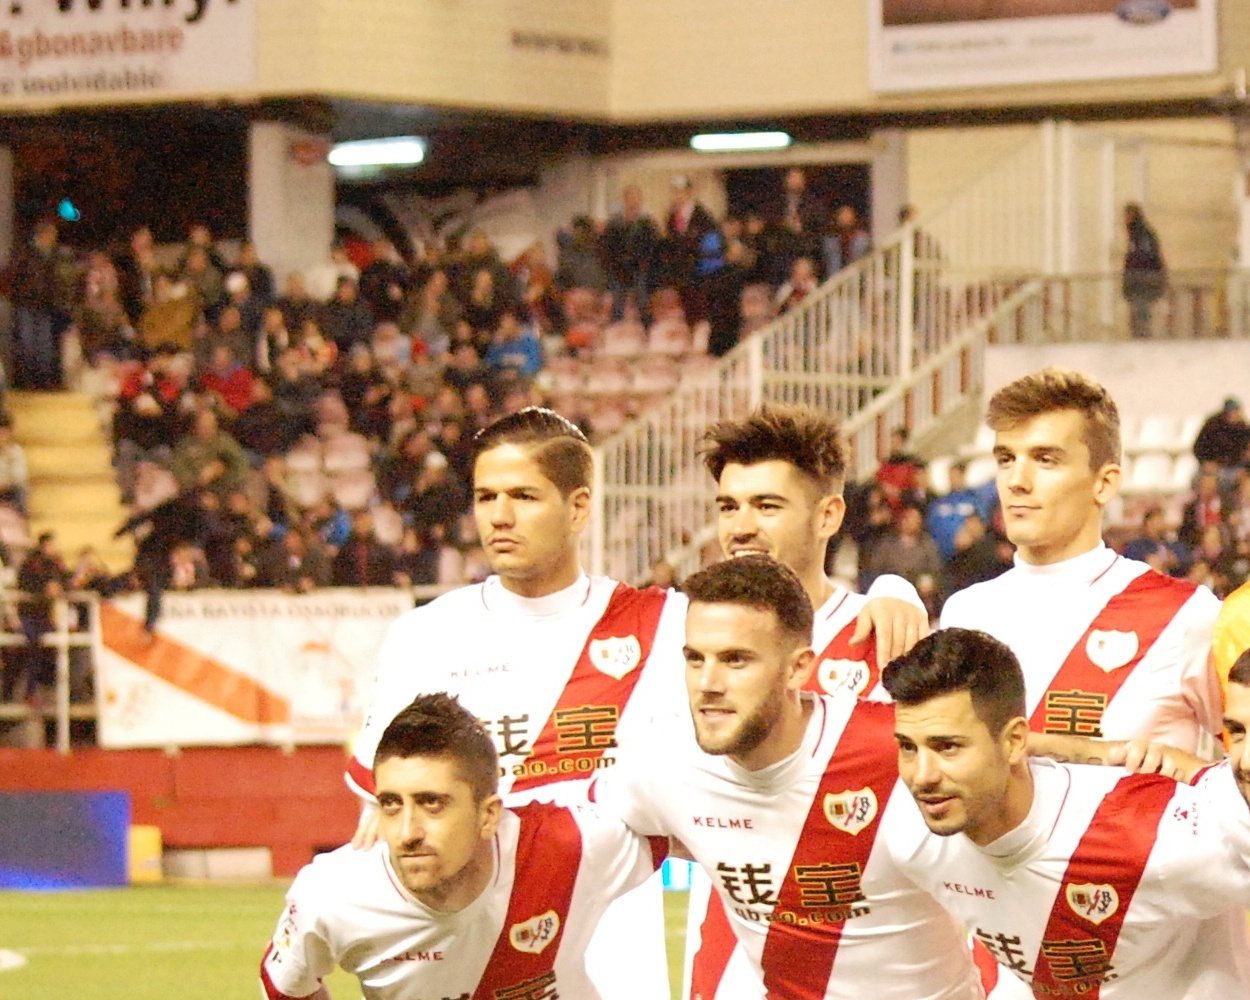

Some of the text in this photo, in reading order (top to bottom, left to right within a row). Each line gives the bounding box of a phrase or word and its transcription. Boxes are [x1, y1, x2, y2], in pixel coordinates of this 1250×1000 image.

[1043, 688, 1107, 738] 宝
[499, 754, 616, 779] ao.com
[693, 815, 754, 829] KELME
[716, 861, 868, 907] 钱宝
[943, 881, 996, 899] KELME
